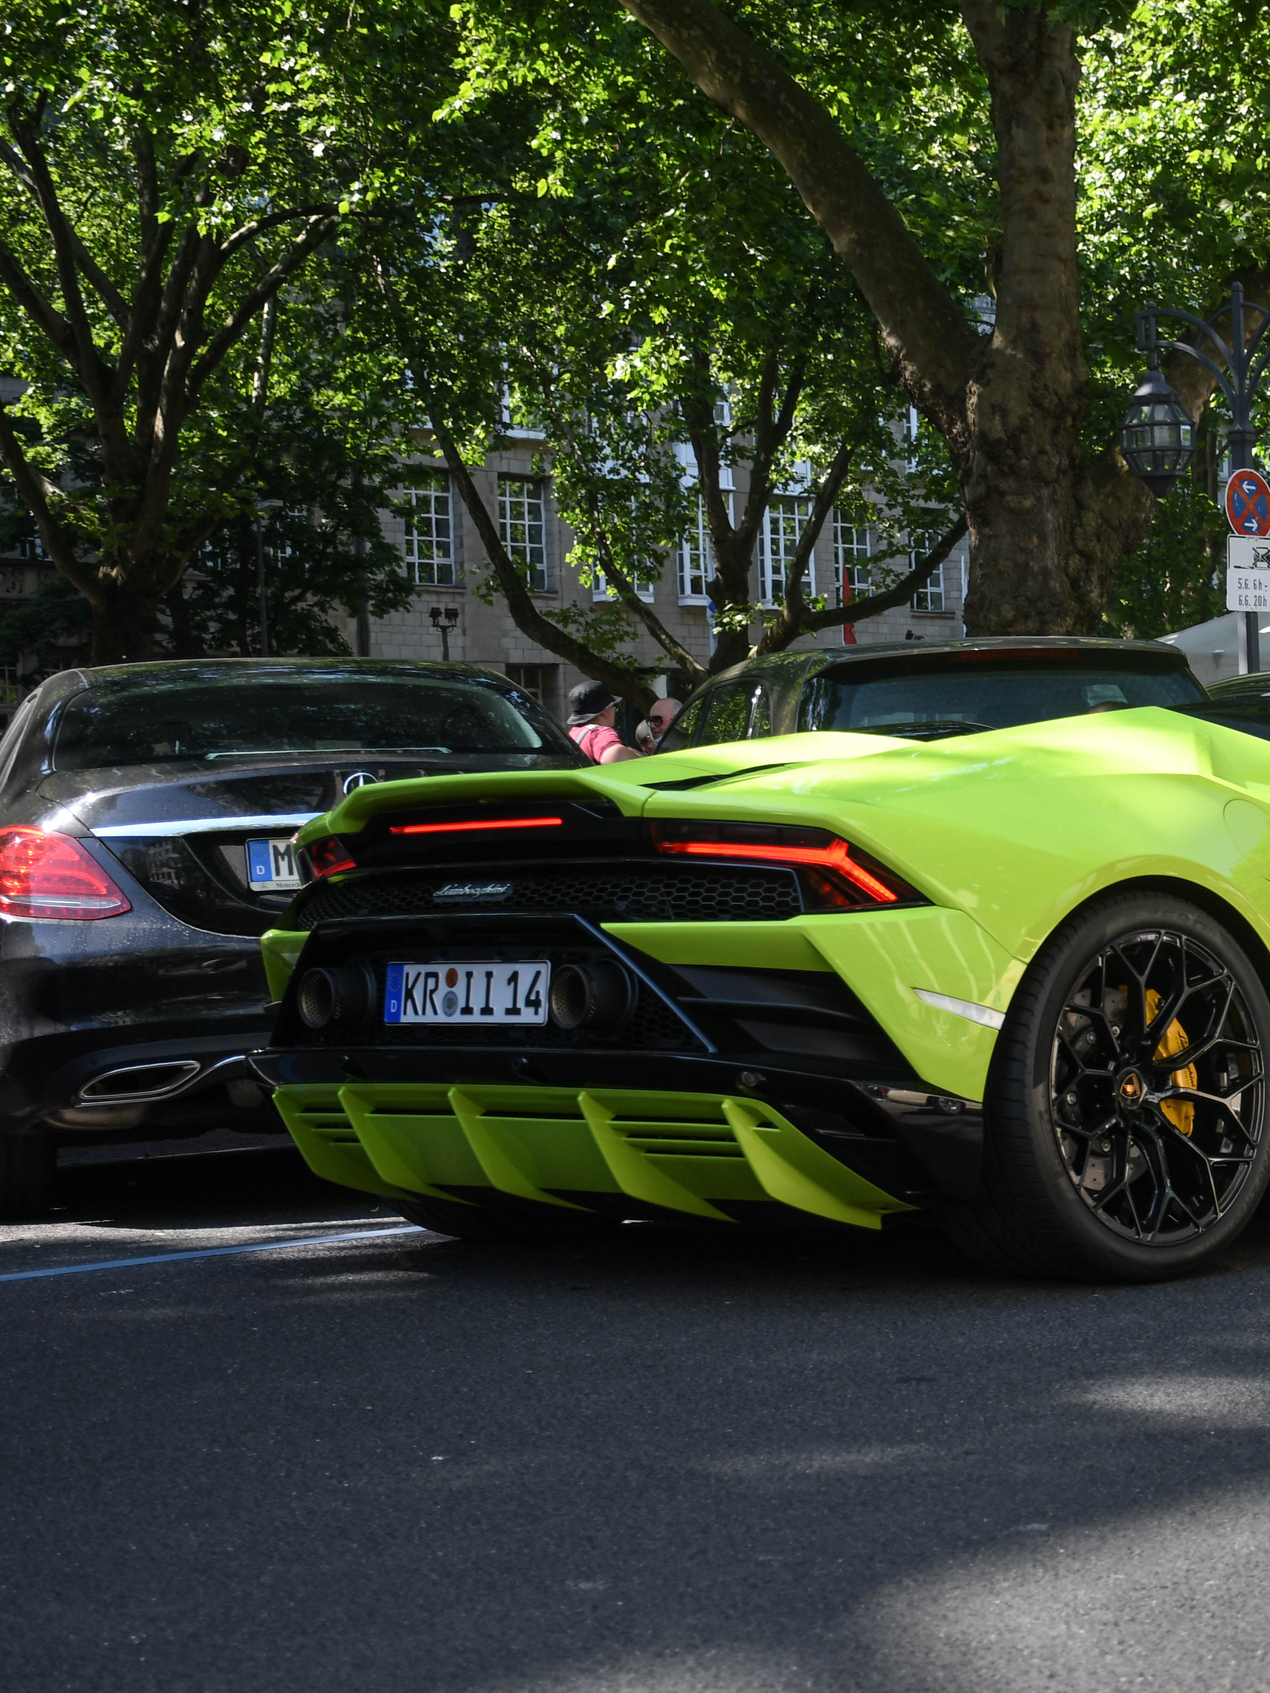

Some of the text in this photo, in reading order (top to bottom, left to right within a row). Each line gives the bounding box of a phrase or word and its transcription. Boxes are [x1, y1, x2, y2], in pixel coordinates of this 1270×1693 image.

[1238, 578, 1250, 590] 5.6.
[256, 865, 265, 875] D
[433, 883, 511, 898] Lamborghini
[390, 970, 542, 1016] D KR II 14
